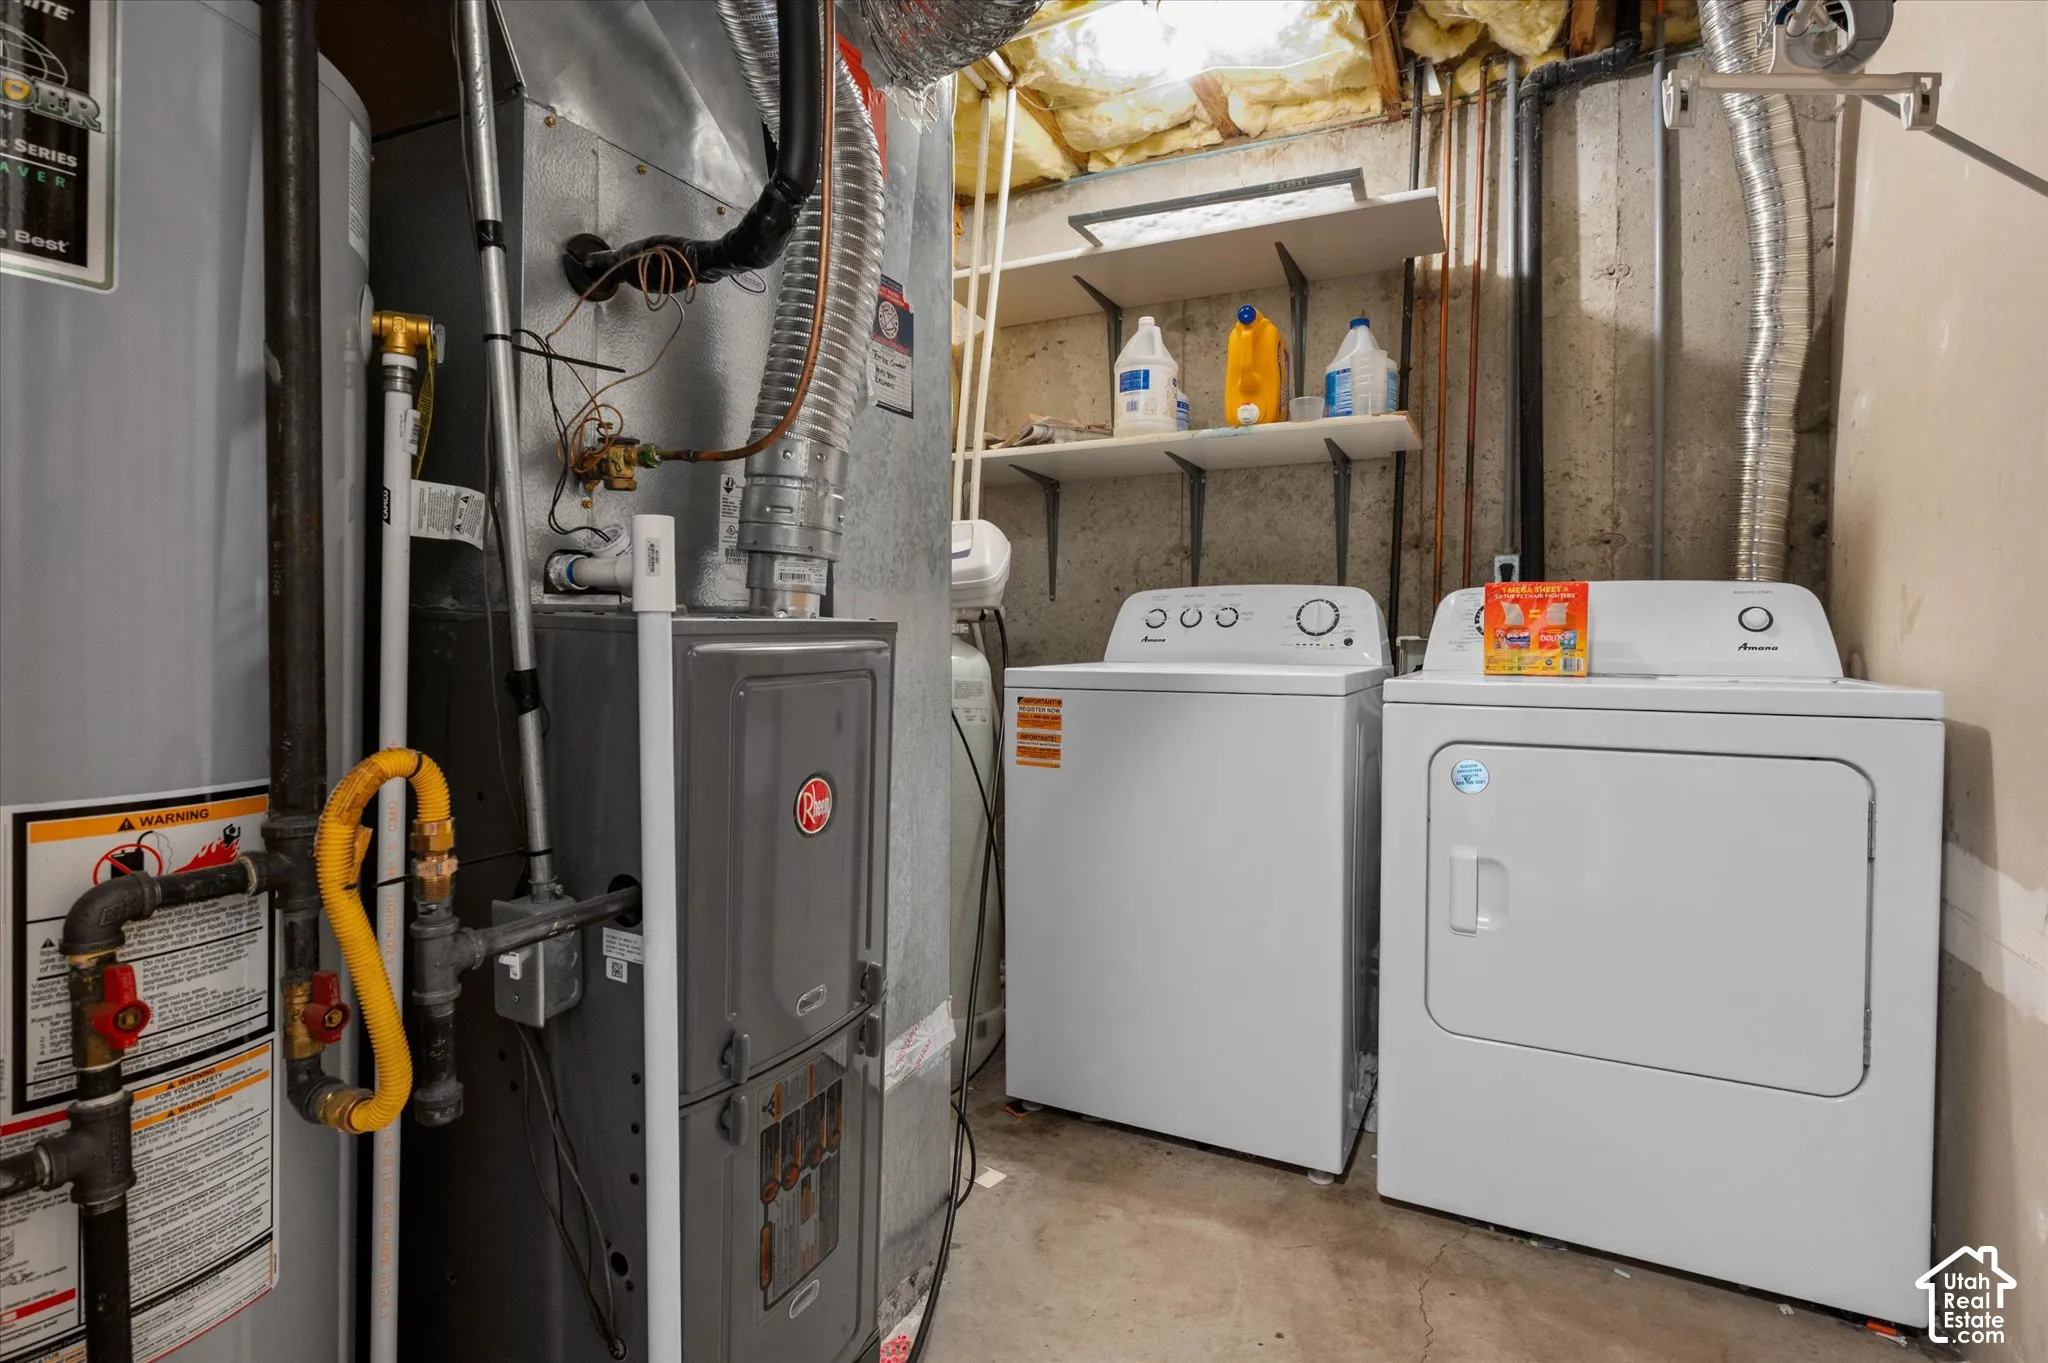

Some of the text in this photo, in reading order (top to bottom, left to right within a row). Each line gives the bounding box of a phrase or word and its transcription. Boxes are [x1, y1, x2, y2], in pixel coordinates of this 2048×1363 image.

[14, 138, 78, 168] SERIES
[14, 229, 67, 253] Best
[1738, 642, 1778, 651] Amana
[802, 784, 831, 825] Rheem
[140, 808, 209, 827] WARNING
[155, 1073, 222, 1100] FOR YOUR SAFETY
[177, 1068, 215, 1084] WARNING
[177, 1094, 215, 1112] WARNING
